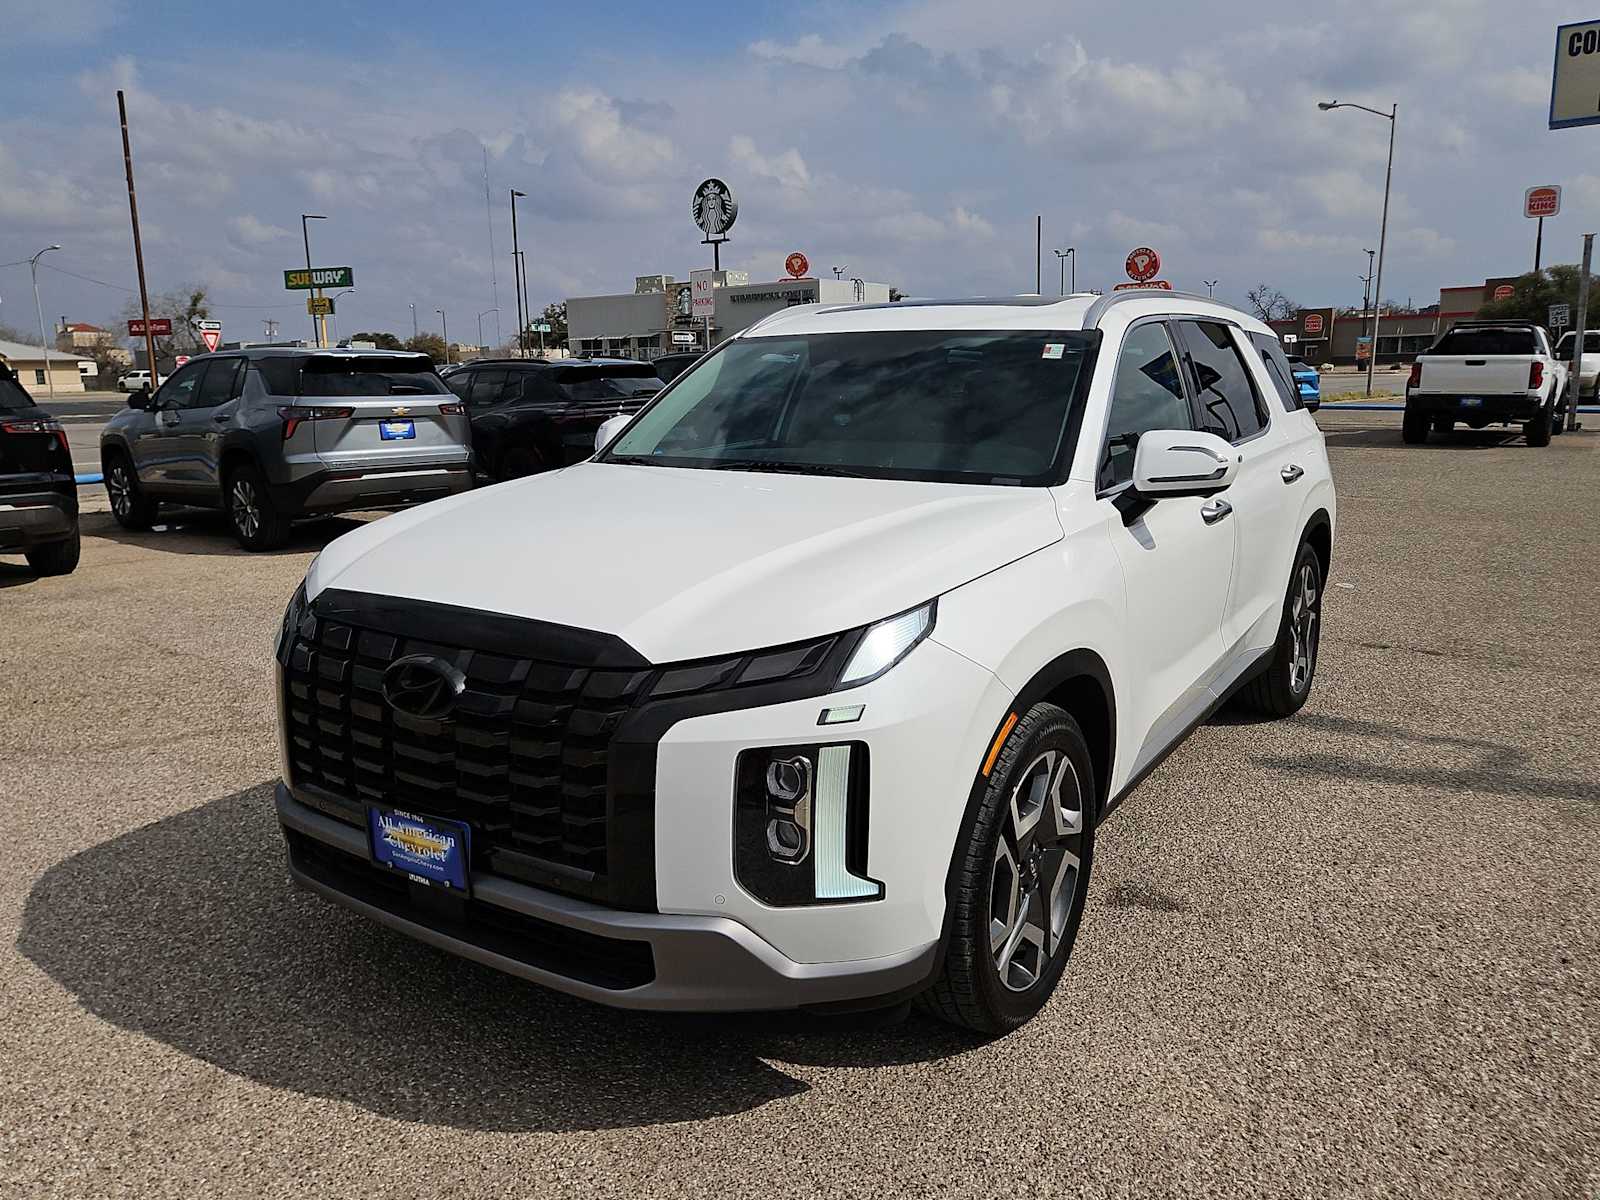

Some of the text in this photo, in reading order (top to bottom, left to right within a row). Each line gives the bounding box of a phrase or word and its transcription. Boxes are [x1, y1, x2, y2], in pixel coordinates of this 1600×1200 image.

[1568, 30, 1600, 57] CO
[1528, 202, 1556, 211] KING
[696, 281, 708, 291] NO
[693, 298, 713, 306] PARKING
[1551, 315, 1567, 325] 35
[394, 809, 411, 819] SINCE
